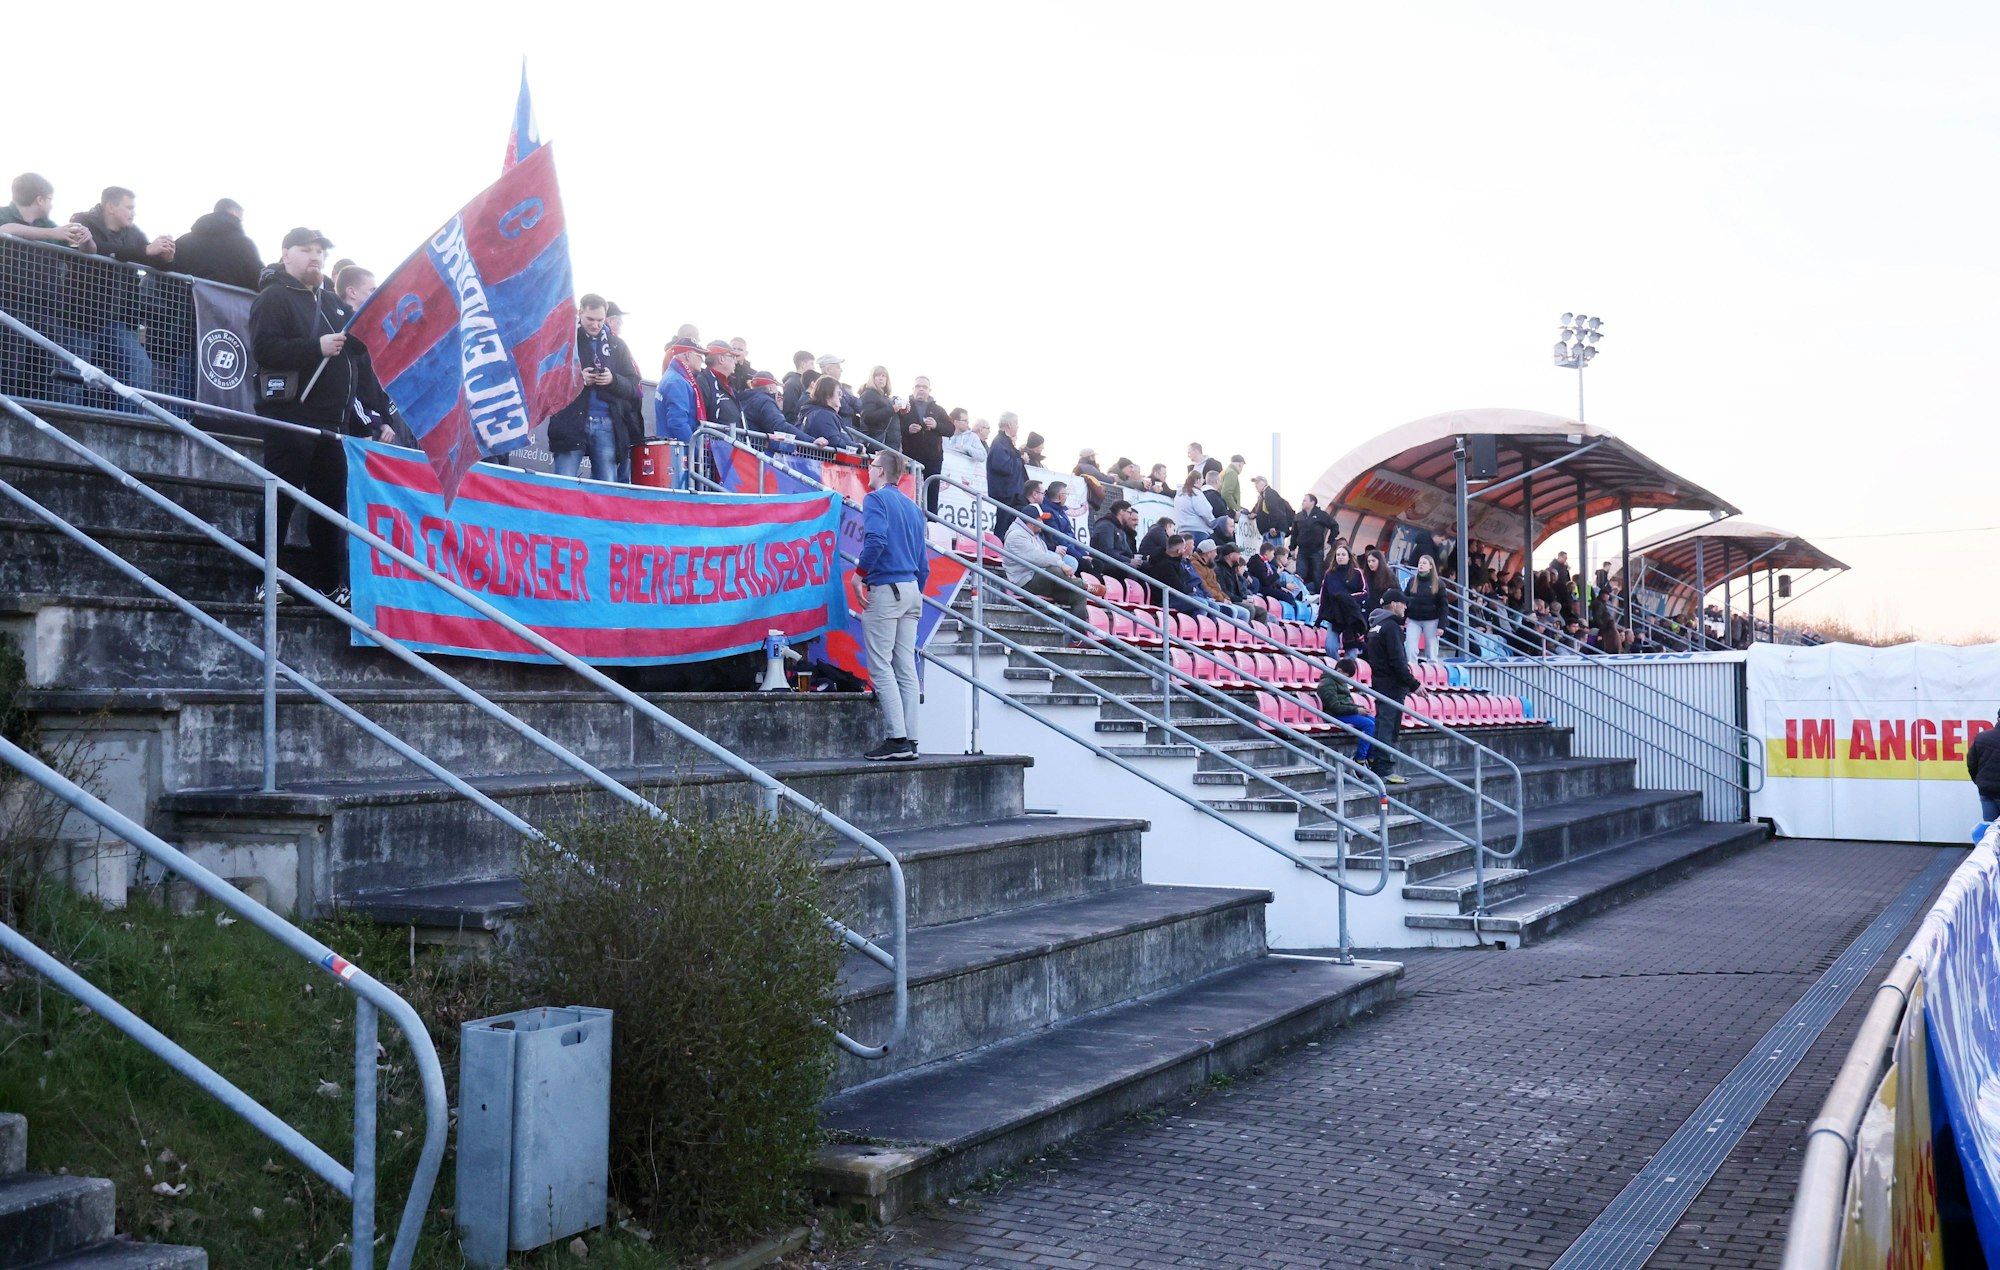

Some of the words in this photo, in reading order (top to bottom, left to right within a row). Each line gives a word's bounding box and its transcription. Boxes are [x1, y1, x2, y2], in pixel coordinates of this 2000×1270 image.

[366, 502, 592, 602] EILENBURGER
[609, 530, 836, 605] BIERGESCHWADER
[1785, 718, 1836, 760] IM
